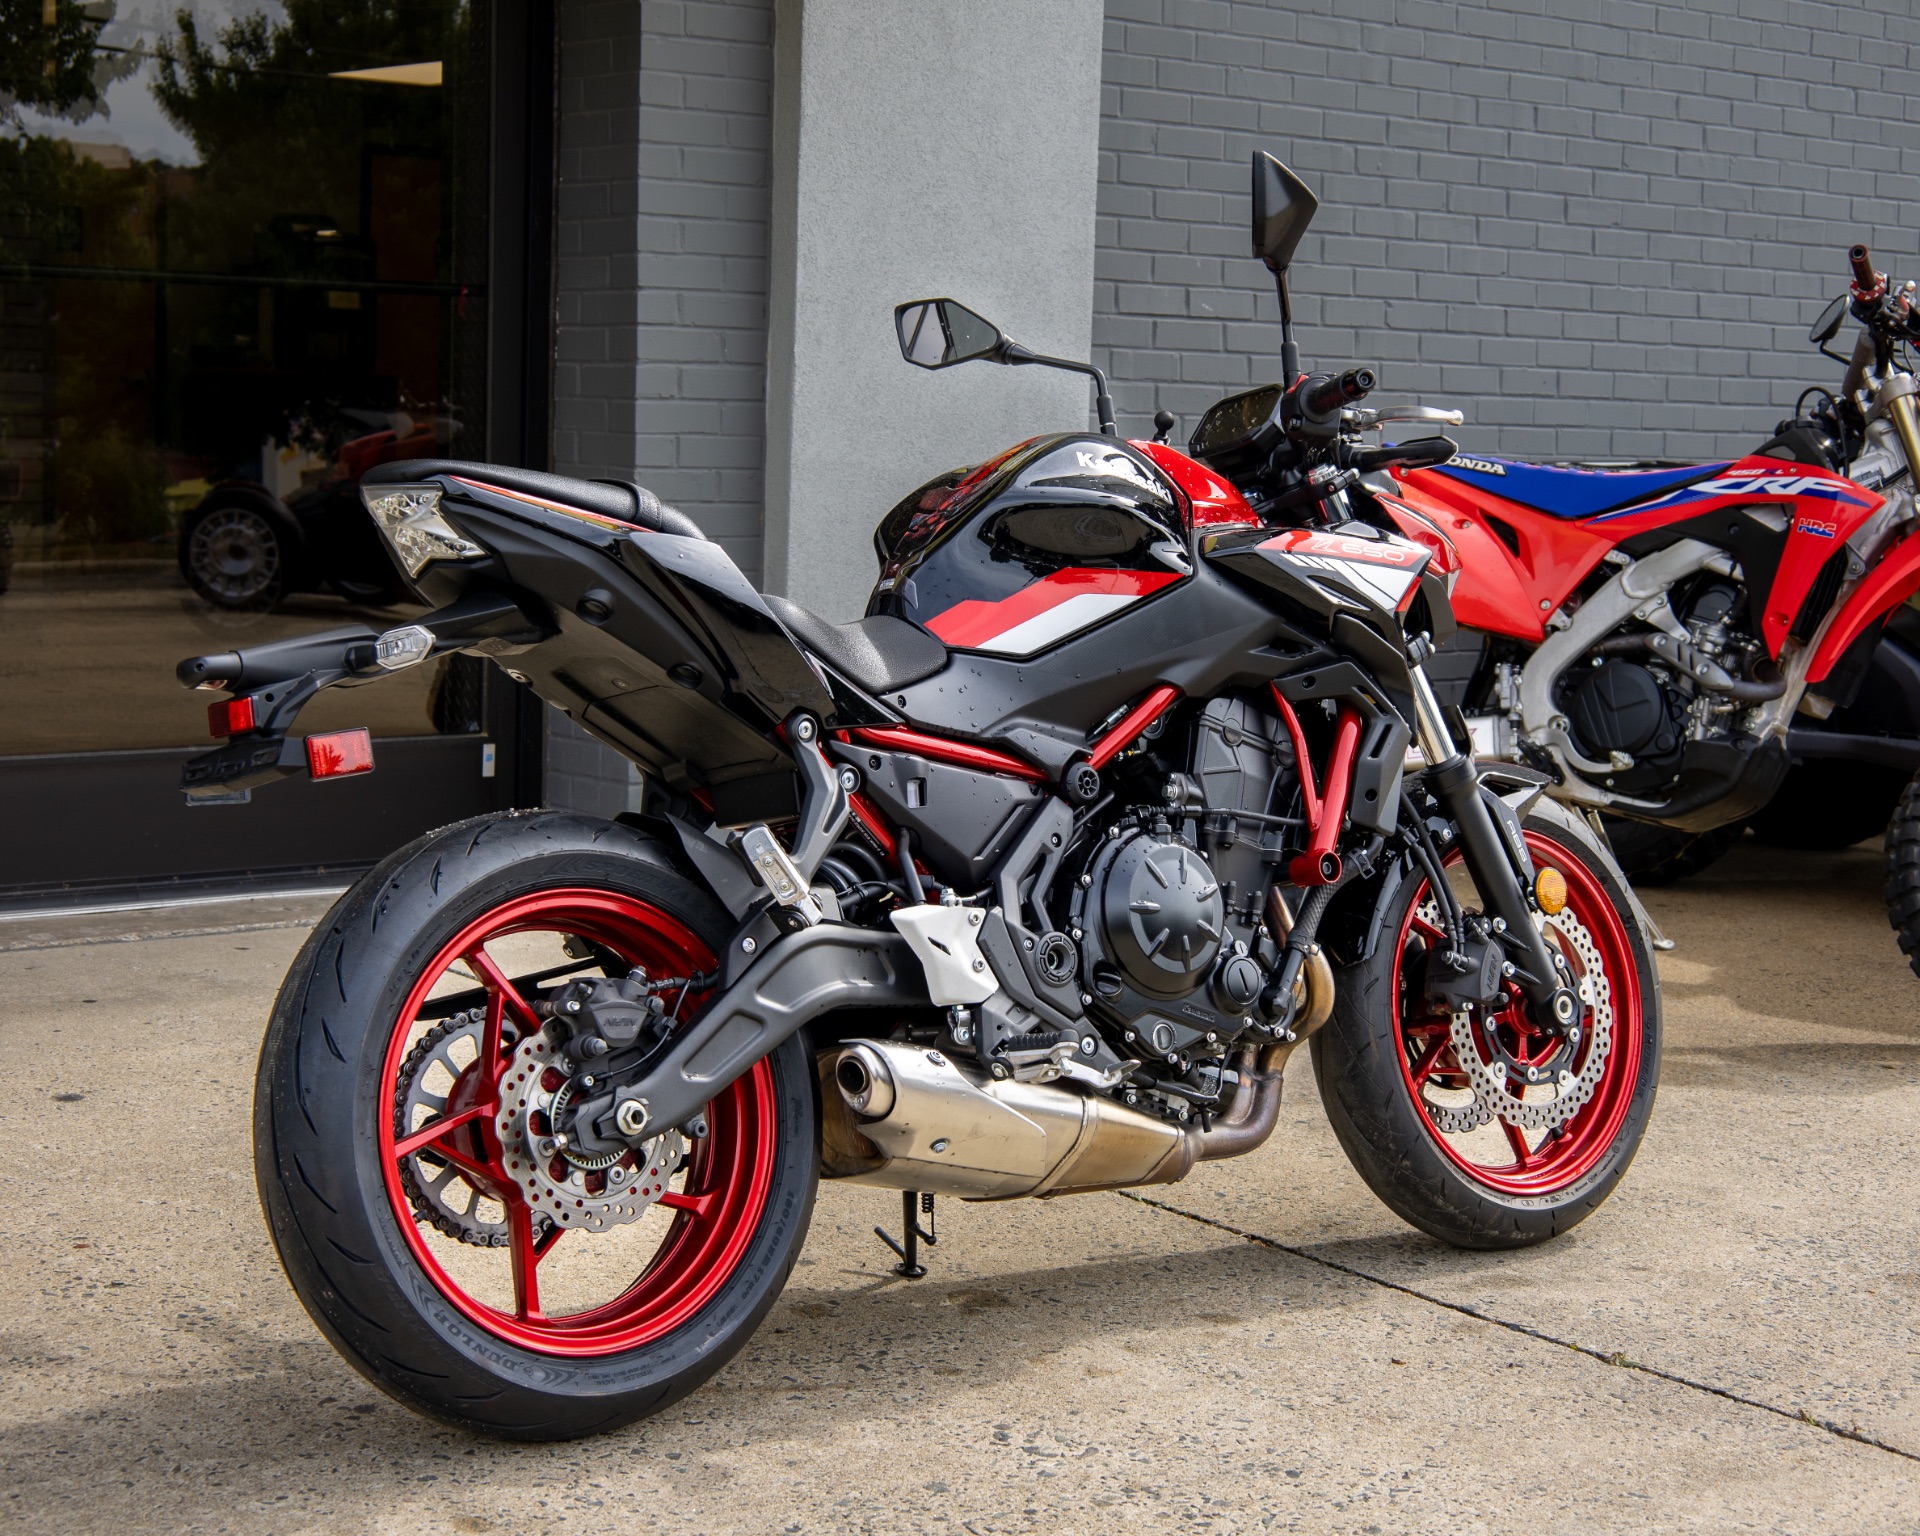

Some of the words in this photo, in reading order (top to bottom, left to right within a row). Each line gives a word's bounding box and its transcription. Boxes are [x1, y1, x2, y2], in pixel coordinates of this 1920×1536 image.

[1447, 456, 1506, 475] ONDA
[1688, 476, 1854, 494] CRF
[1797, 517, 1837, 538] HRC
[1507, 820, 1527, 862] ABS
[433, 1312, 519, 1372] DUNLOP
